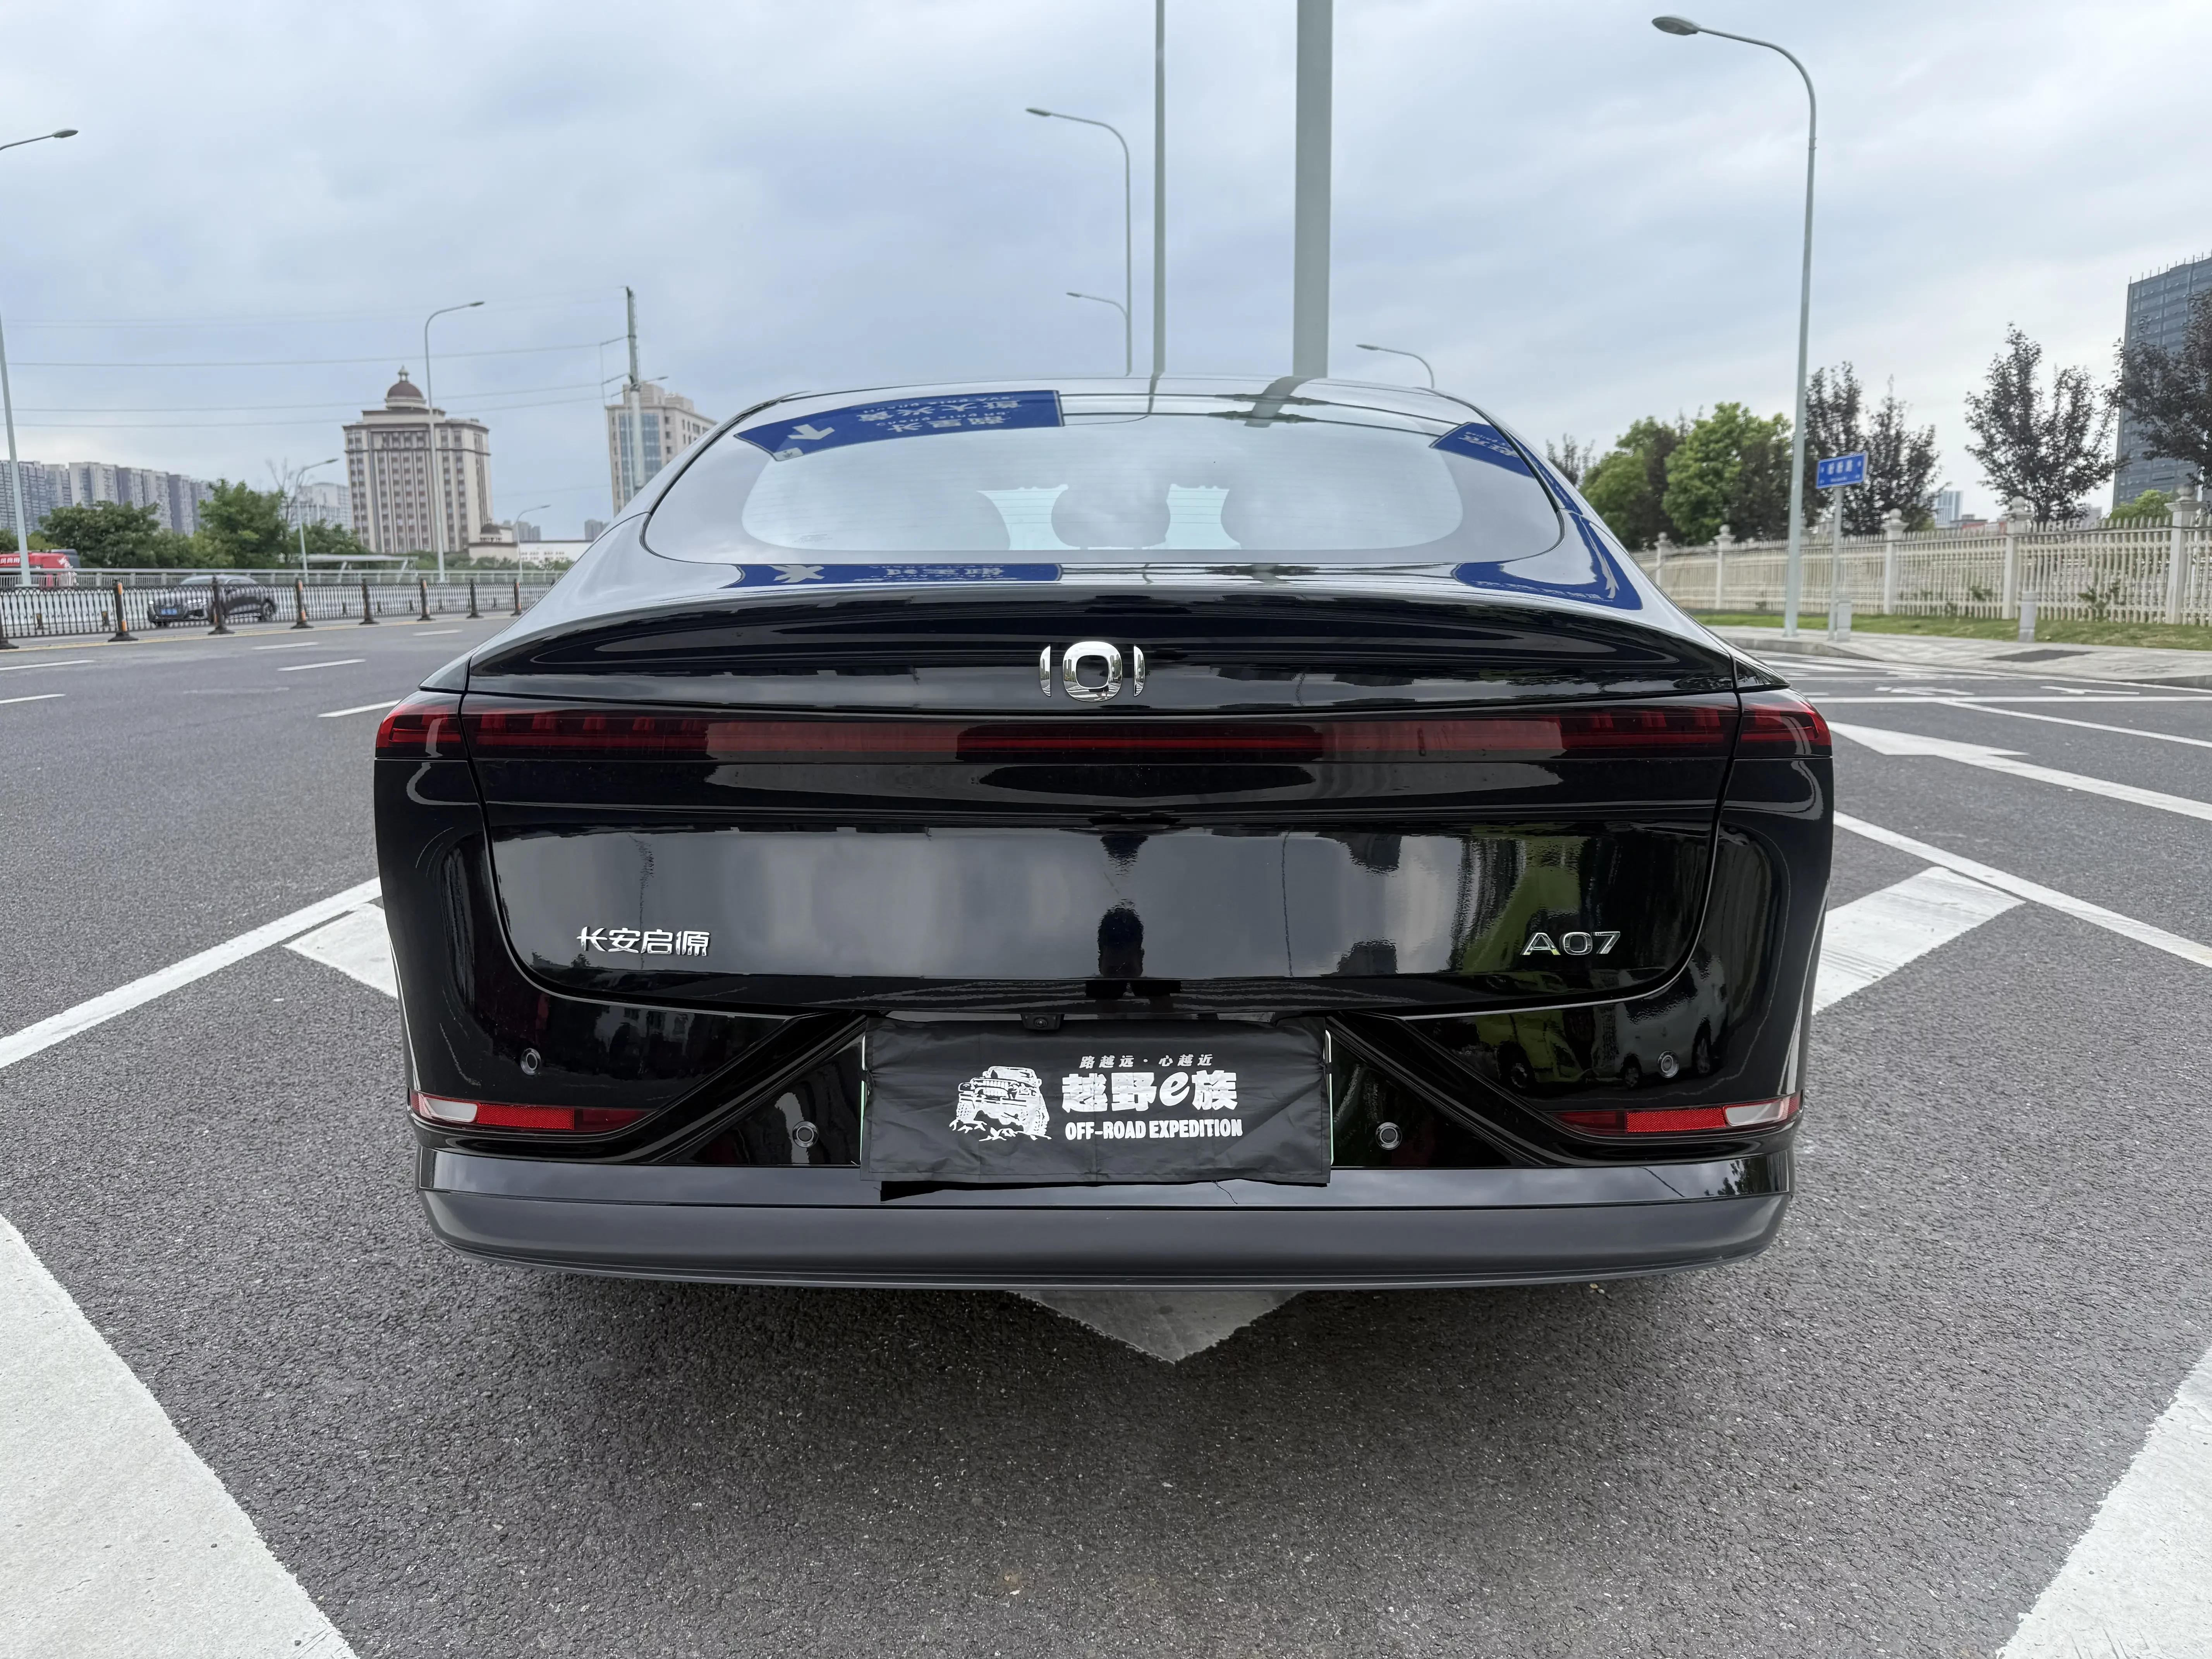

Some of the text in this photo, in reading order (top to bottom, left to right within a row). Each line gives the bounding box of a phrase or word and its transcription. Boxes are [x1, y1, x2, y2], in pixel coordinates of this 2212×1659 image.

[576, 927, 710, 956] 长安启源
[1520, 931, 1621, 955] A07
[1062, 1070, 1238, 1113] 越野e族
[1065, 1119, 1243, 1140] OFF-ROAD EXPEDITION
